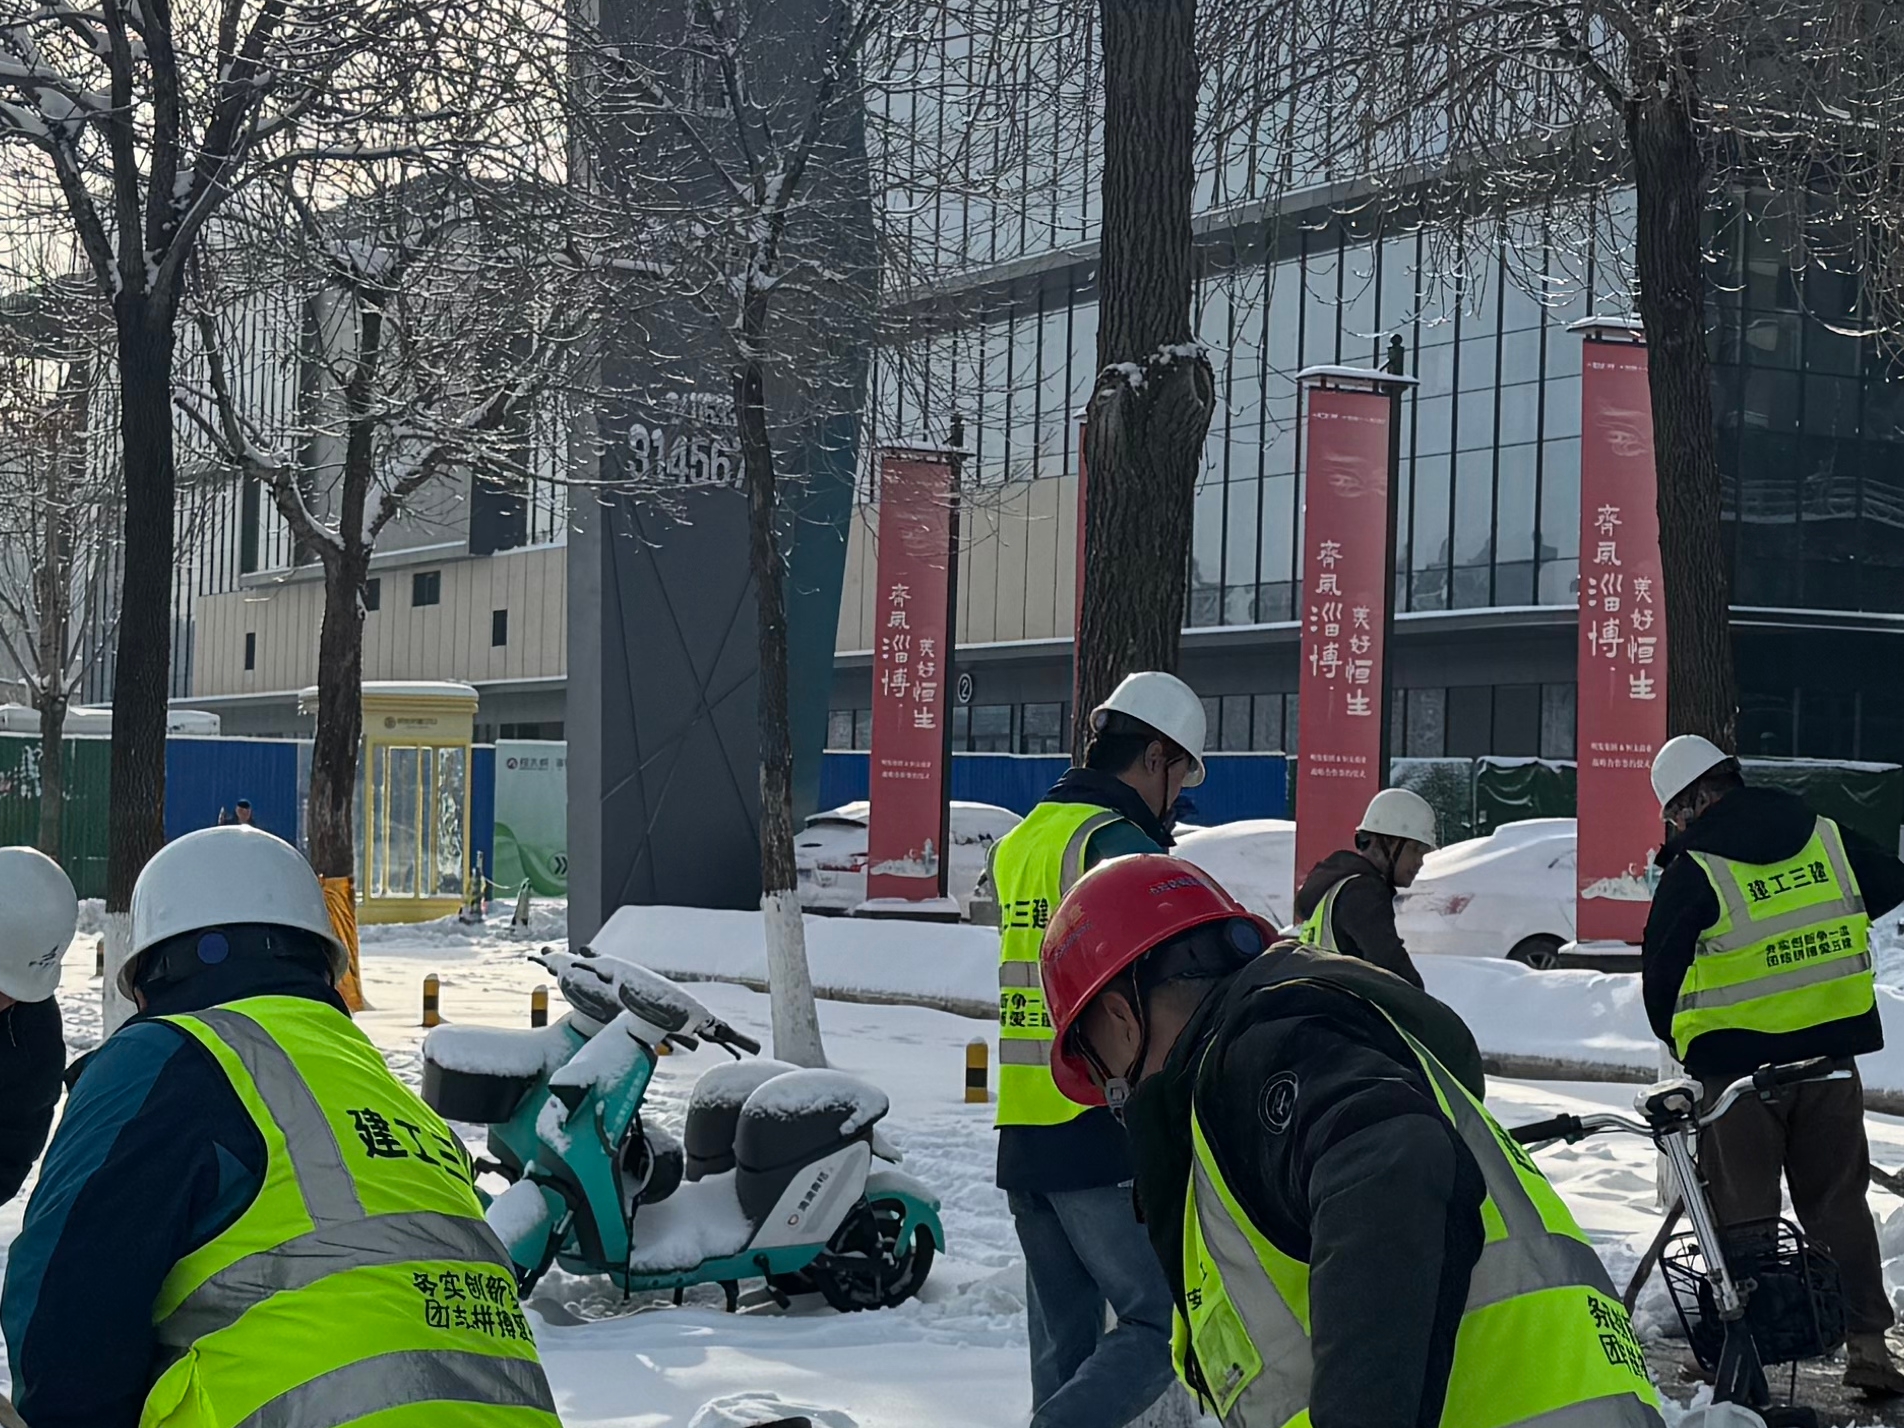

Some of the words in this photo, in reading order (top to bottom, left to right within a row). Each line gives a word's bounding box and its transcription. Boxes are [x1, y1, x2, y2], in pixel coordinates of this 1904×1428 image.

[912, 638, 937, 729] 美好恒生
[1345, 606, 1372, 717] 美好恒生
[1628, 576, 1657, 700] 美好恒生
[1747, 861, 1829, 903] 建工三建
[346, 1106, 476, 1187] 建工三
